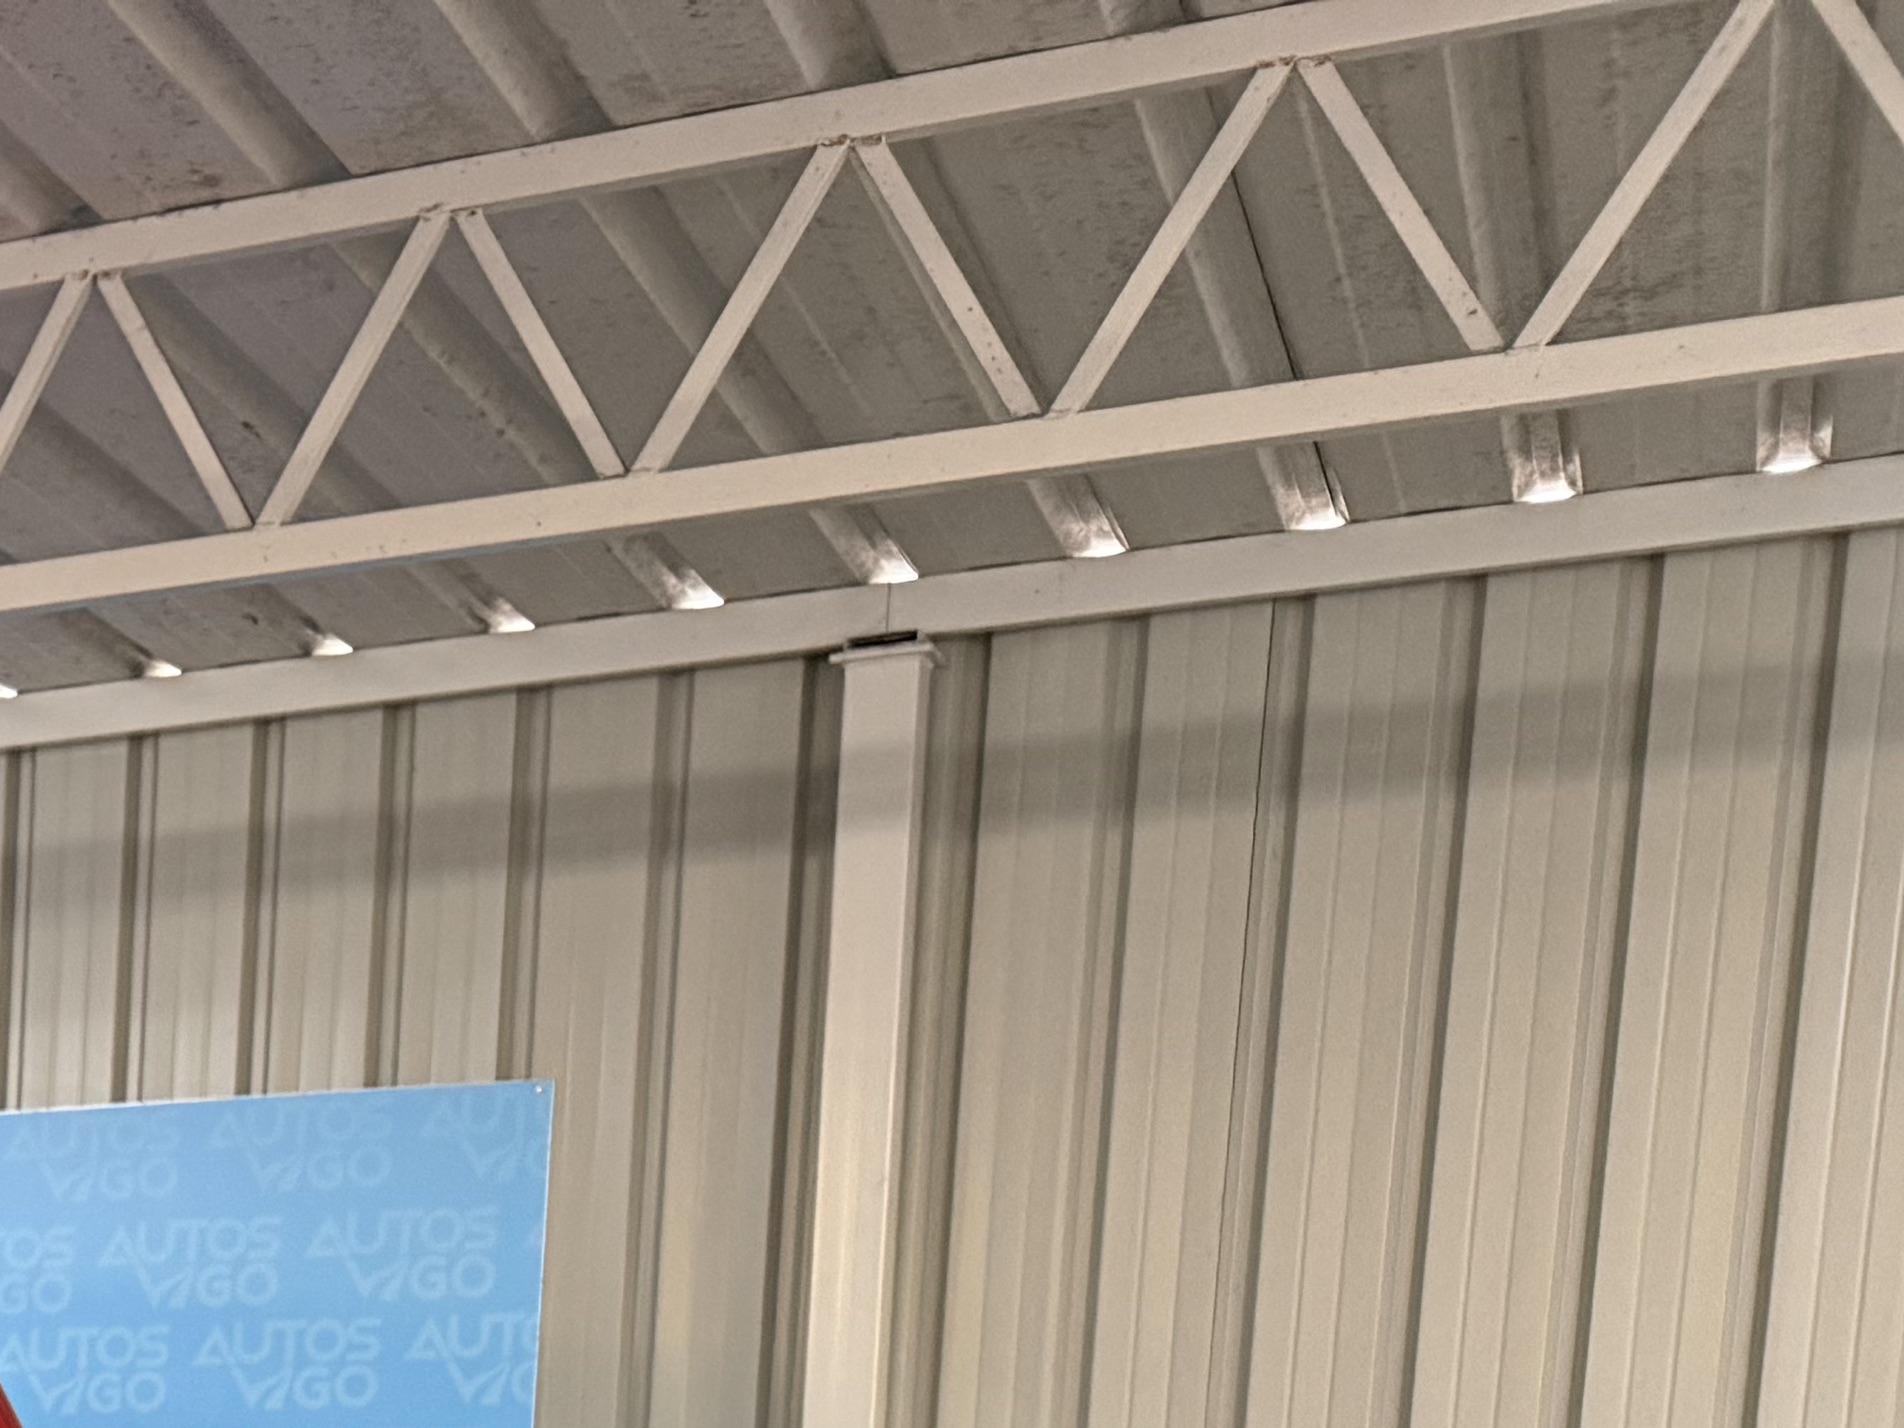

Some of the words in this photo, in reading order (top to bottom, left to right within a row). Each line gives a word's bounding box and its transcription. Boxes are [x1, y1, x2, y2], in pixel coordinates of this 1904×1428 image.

[98, 1215, 283, 1266] AUTOS
[304, 1206, 499, 1260] AUTOS
[133, 1261, 279, 1310] VIGO
[341, 1254, 496, 1302] VIGO
[193, 1316, 382, 1366] AUTOS
[28, 1371, 167, 1415] VIGO
[229, 1364, 379, 1411] VIGO
